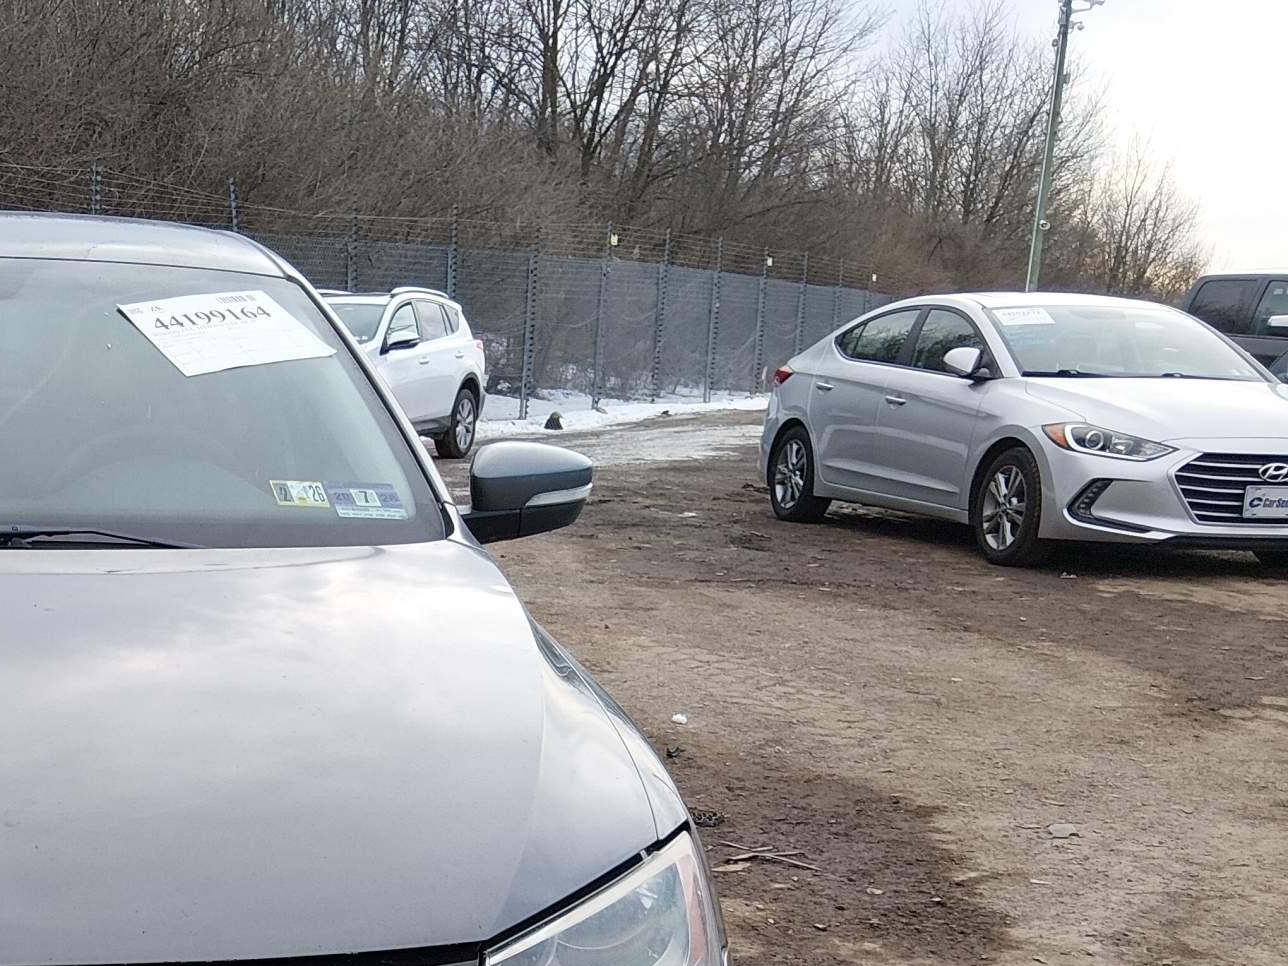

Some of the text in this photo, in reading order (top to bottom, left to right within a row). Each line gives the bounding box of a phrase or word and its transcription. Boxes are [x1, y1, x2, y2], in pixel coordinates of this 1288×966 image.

[154, 305, 272, 331] 44199164
[308, 485, 326, 502] 26
[358, 490, 370, 503] 7
